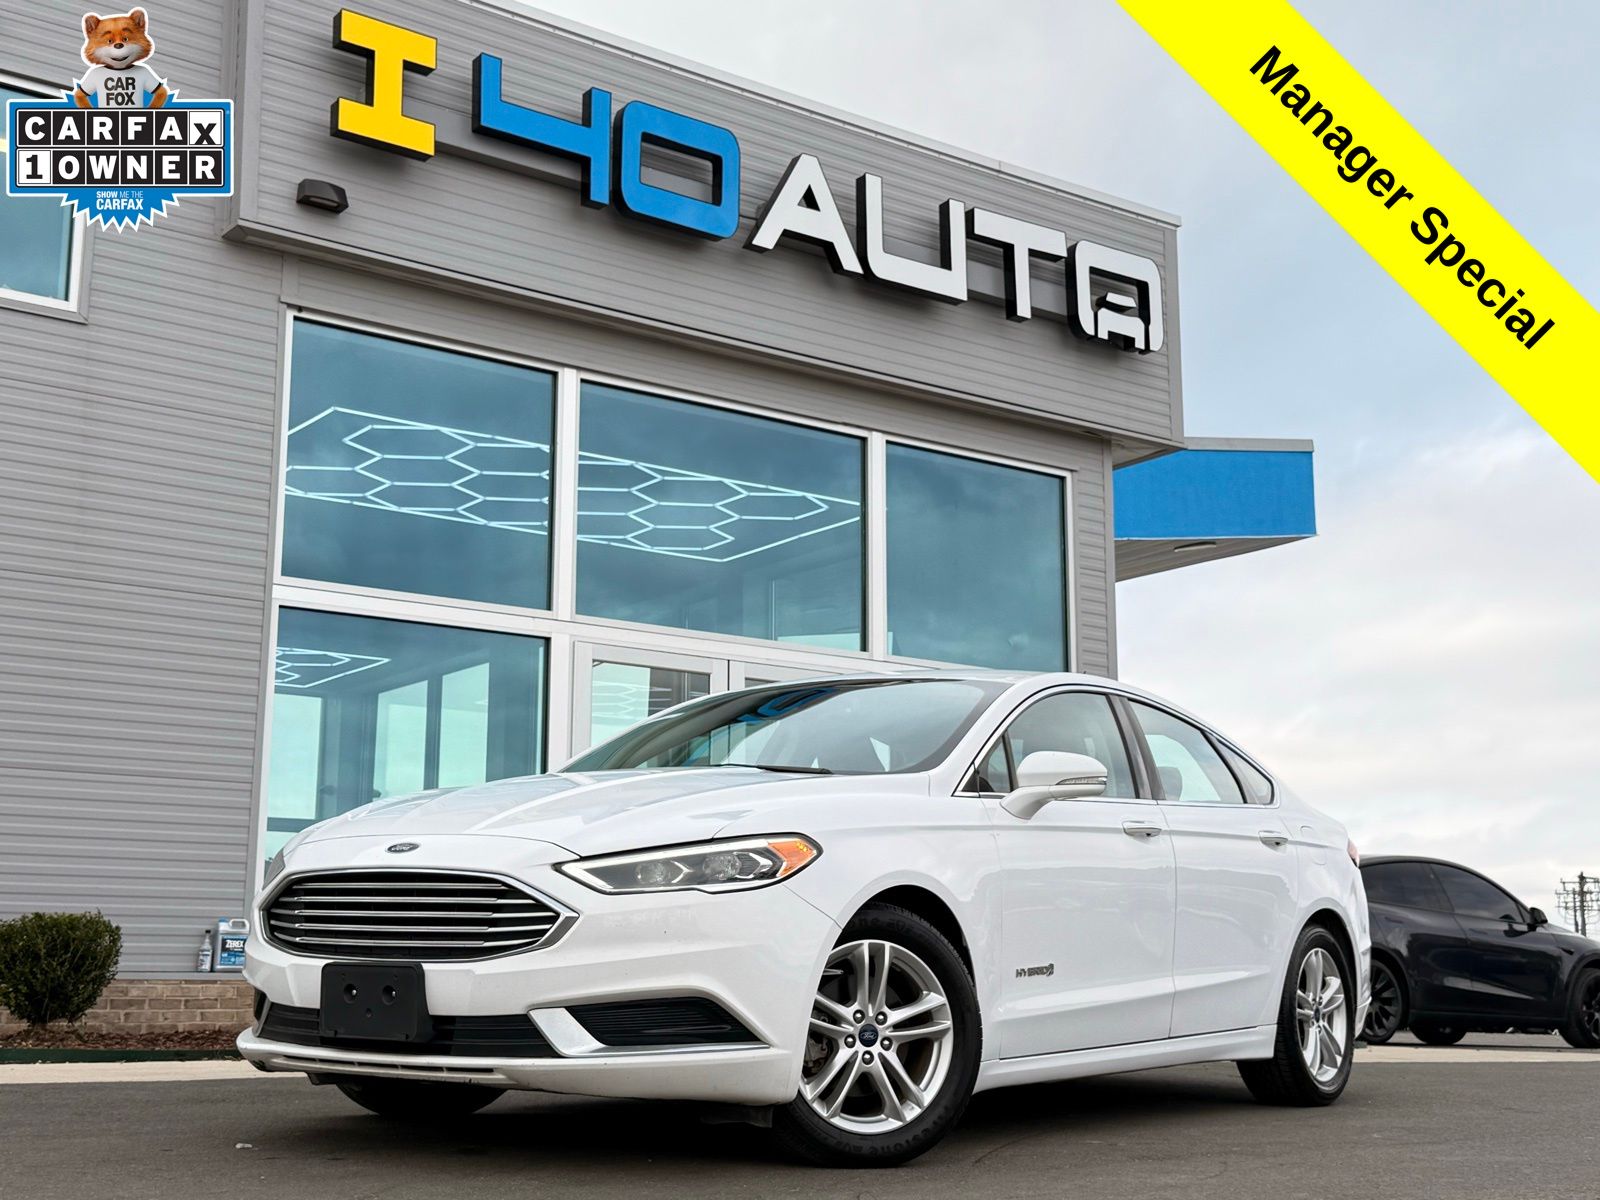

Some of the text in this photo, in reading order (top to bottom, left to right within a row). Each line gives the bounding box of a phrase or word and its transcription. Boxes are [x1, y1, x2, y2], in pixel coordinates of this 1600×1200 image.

[331, 8, 1165, 354] I 40 AUTO
